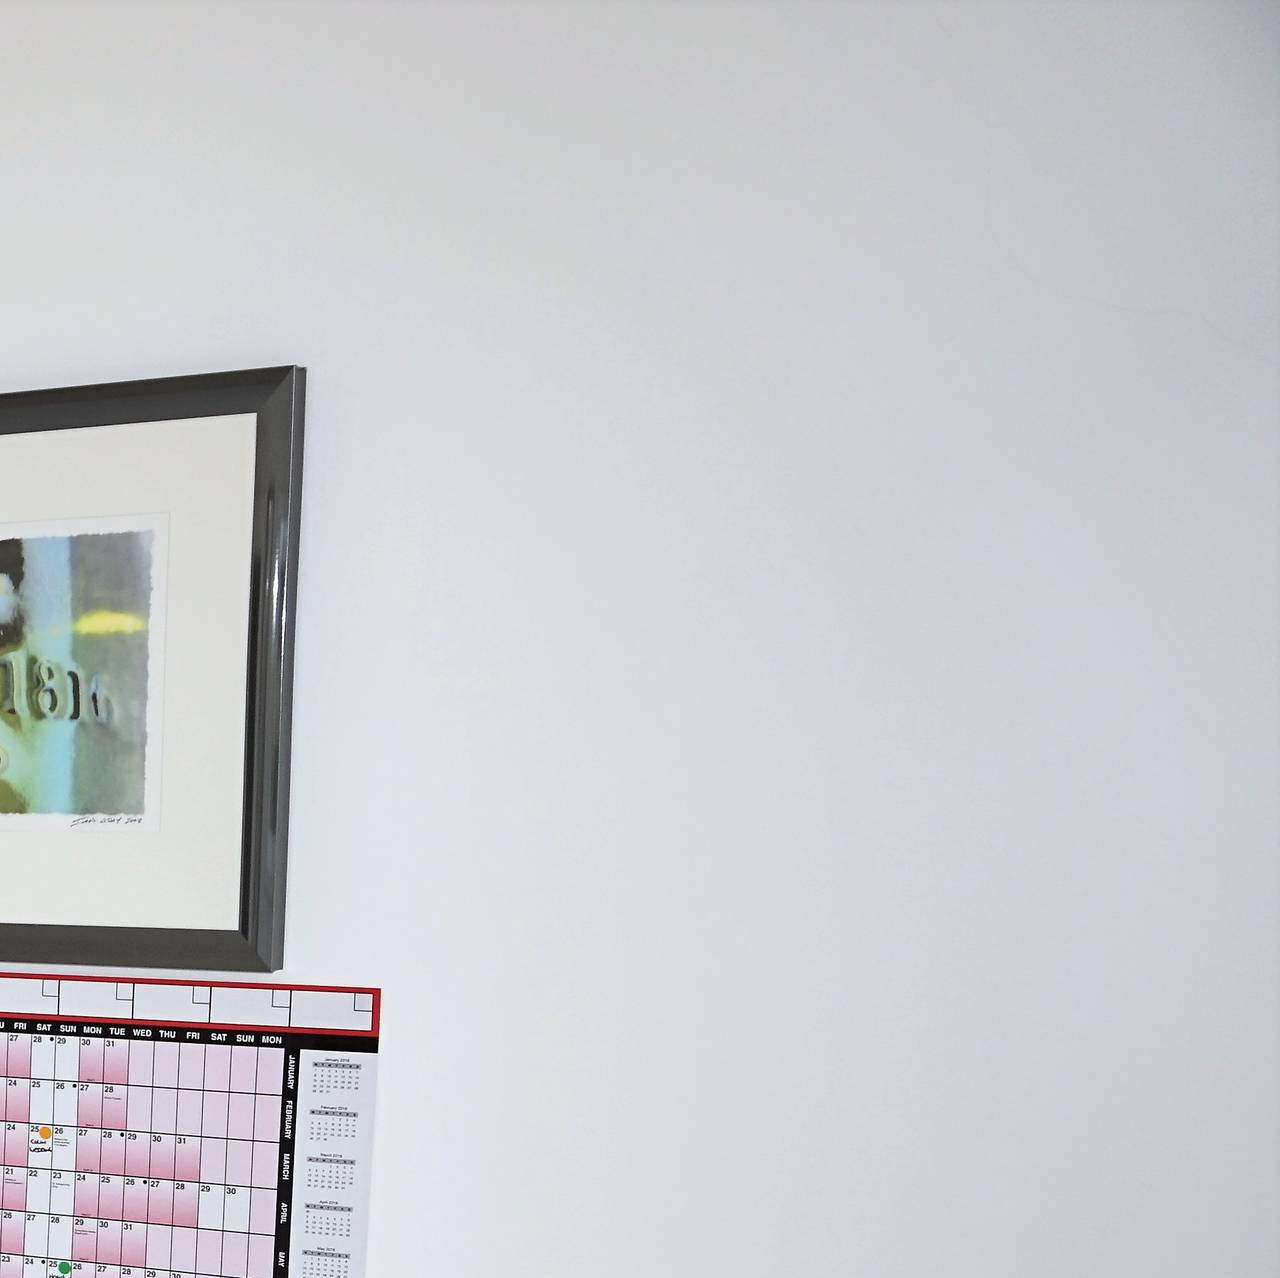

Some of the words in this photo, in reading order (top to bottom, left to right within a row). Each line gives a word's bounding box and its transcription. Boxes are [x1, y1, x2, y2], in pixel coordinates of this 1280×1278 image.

[13, 1021, 27, 1030] FRI
[36, 1023, 53, 1032] SAT
[59, 1024, 77, 1033] SUN
[83, 1025, 103, 1035] MON
[108, 1027, 126, 1036] TUE
[132, 1028, 153, 1038] WED
[158, 1029, 177, 1039] THU
[186, 1031, 201, 1040] FRI
[210, 1032, 228, 1042] SAT
[236, 1034, 255, 1043] SUN
[261, 1035, 283, 1045] MON
[287, 1054, 296, 1090] JANUARY
[284, 1100, 294, 1140] FEBRUARY
[282, 1153, 291, 1181] MARCH
[279, 1202, 289, 1225] APRIL
[277, 1251, 286, 1268] MAY
